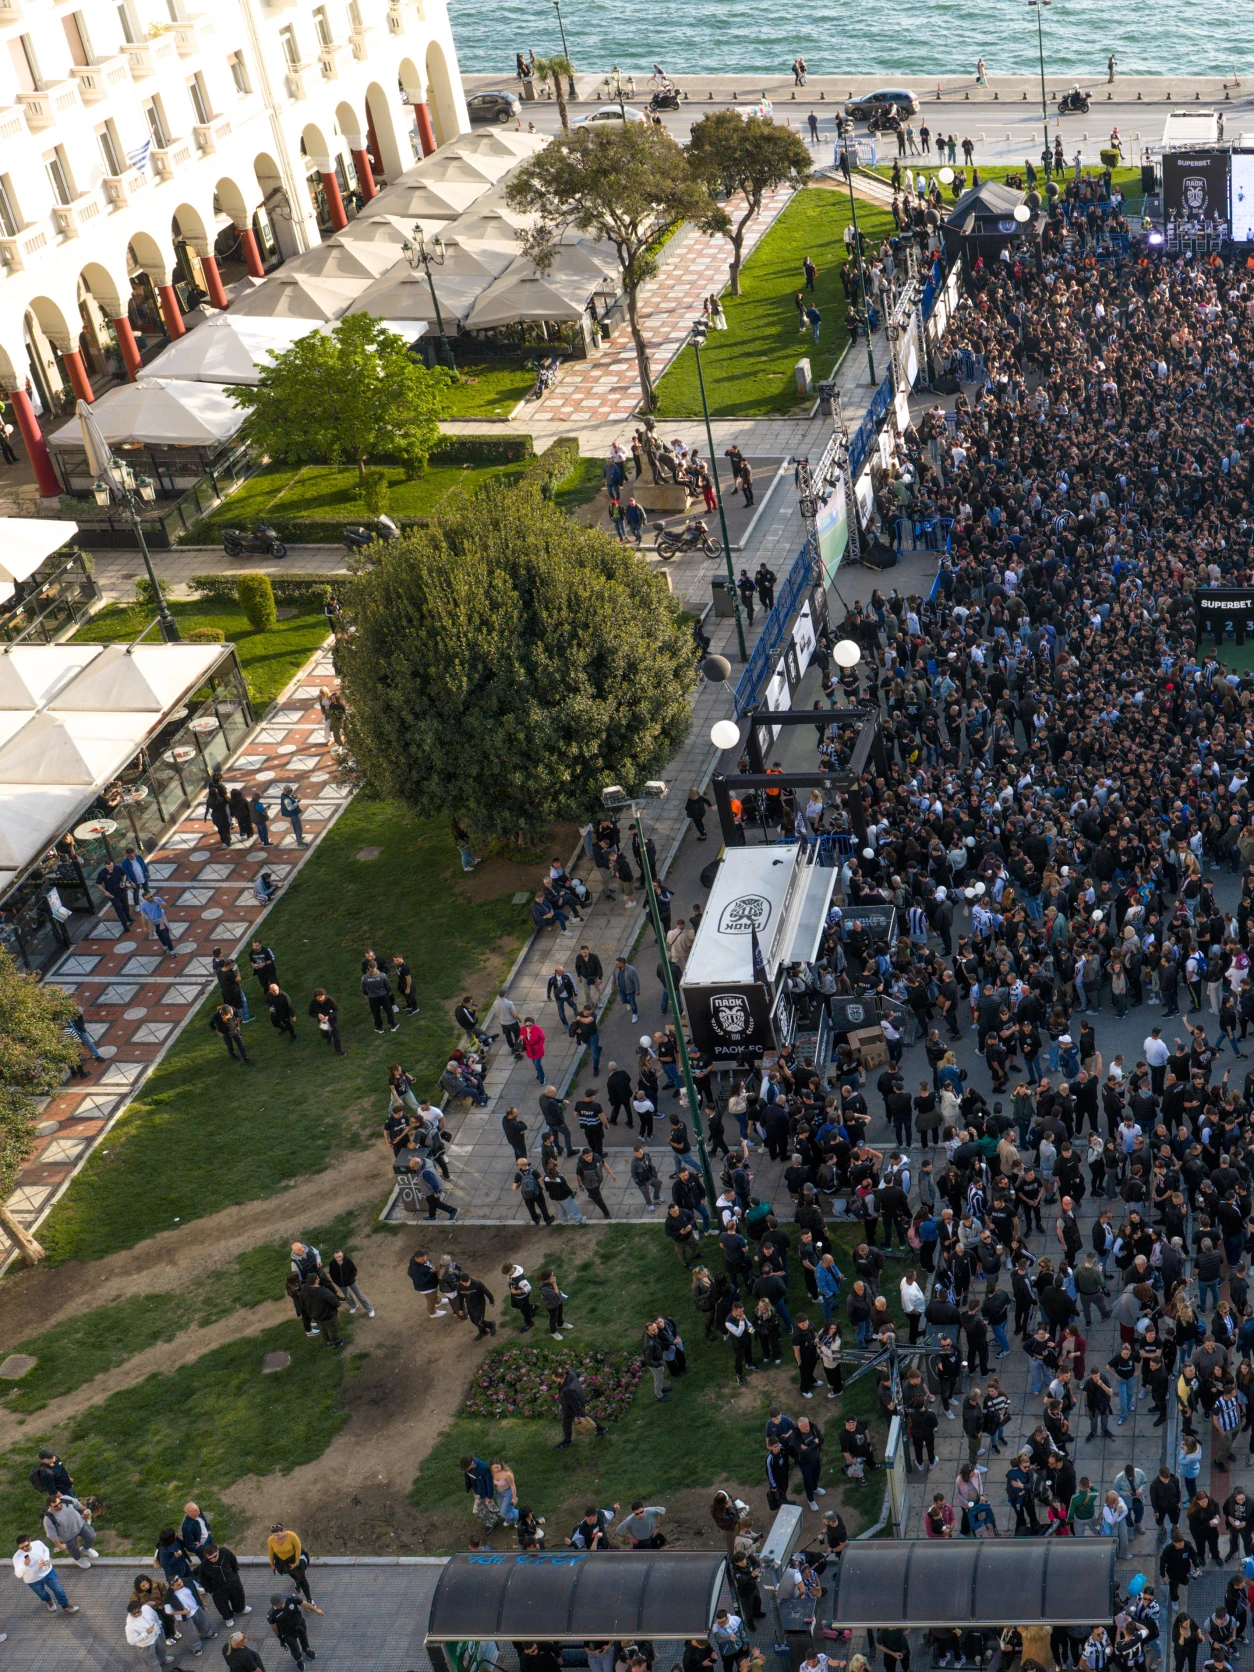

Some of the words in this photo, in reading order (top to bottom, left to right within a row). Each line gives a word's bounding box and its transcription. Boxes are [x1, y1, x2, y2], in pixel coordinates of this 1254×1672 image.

[1177, 159, 1211, 167] SUPERBET
[1201, 599, 1252, 609] SUPERBET
[1205, 620, 1211, 631] 1
[1225, 620, 1234, 631] 2
[1246, 620, 1254, 631] 3
[715, 999, 743, 1007] ΠΑΟΚ
[715, 1046, 746, 1055] PAOK
[748, 1045, 764, 1054] FC
